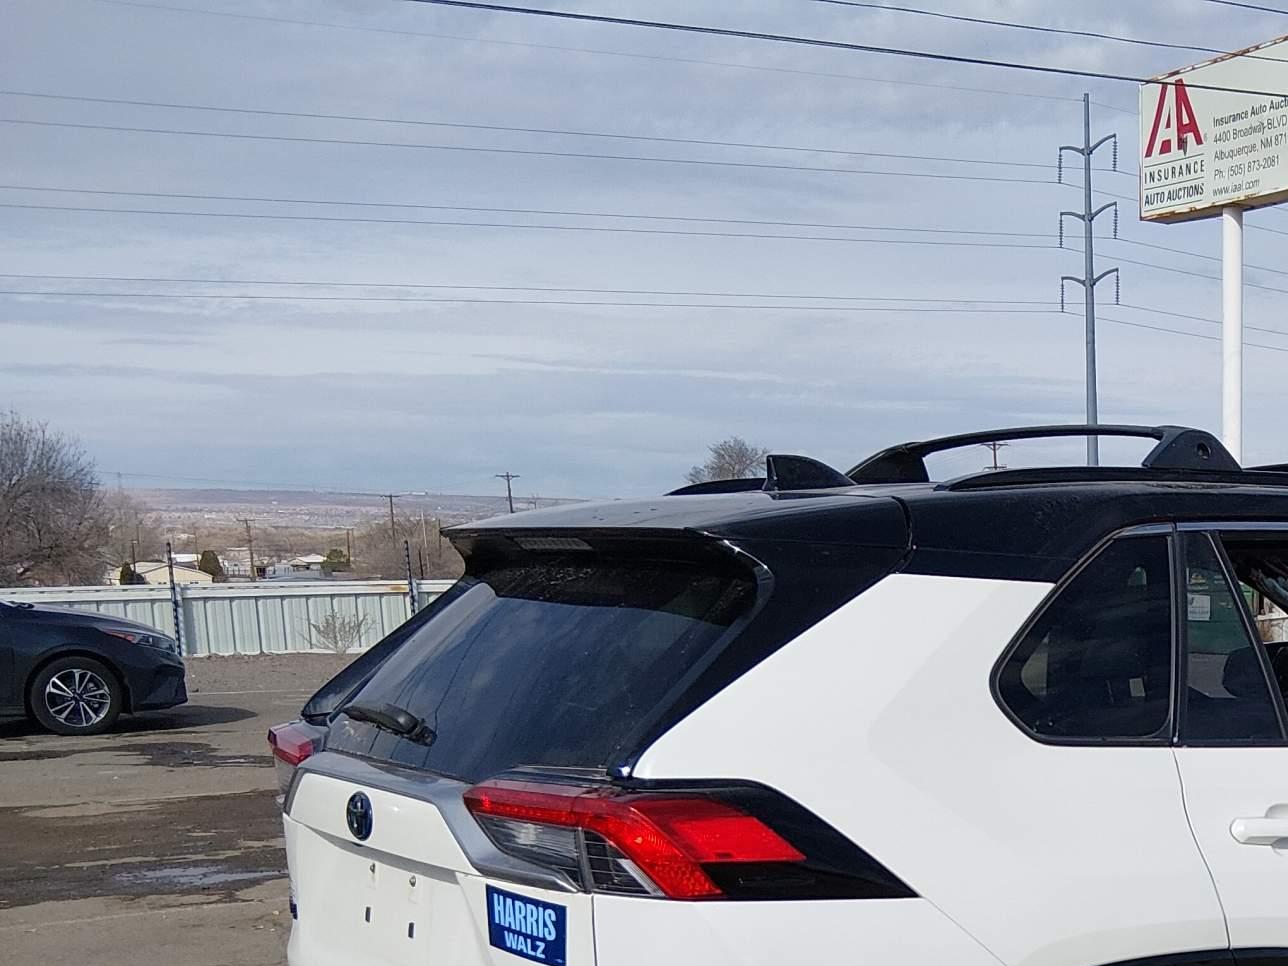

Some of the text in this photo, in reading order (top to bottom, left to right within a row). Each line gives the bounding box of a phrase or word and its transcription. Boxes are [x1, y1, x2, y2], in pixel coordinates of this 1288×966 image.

[1213, 110, 1249, 128] Insurance
[1250, 104, 1267, 118] Auto
[1213, 130, 1231, 145] 4400
[1260, 136, 1273, 150] NM
[1144, 160, 1205, 184] INSURANCE
[1227, 162, 1246, 180] (505)
[1144, 183, 1205, 207] AUTO AUCTIONS
[493, 893, 557, 941] HARRIS
[503, 930, 546, 959] WALZ
